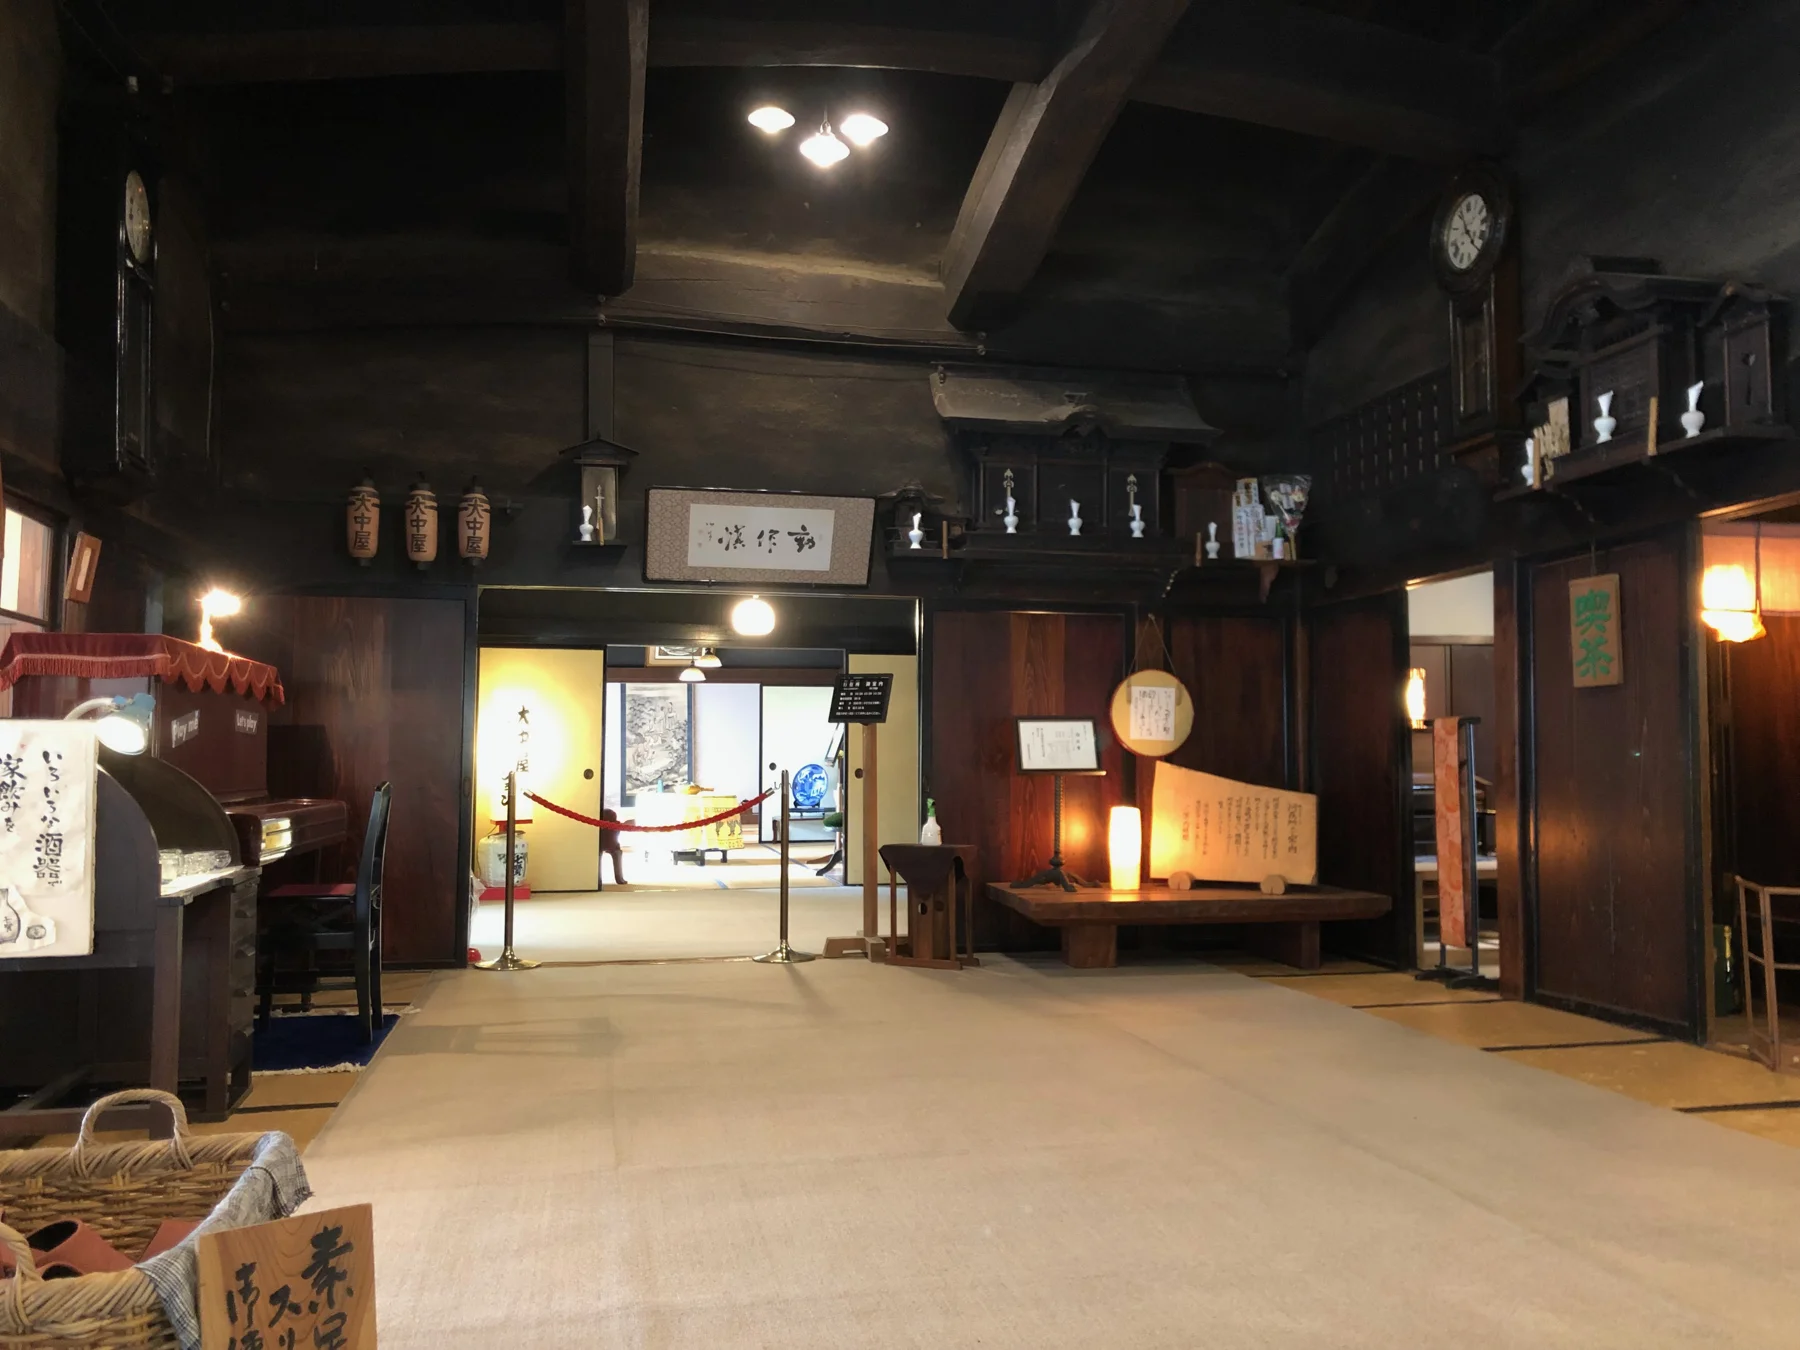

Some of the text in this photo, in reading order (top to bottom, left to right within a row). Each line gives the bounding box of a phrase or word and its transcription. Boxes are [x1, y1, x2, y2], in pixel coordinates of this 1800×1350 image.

[354, 494, 372, 551] 大中屋
[410, 497, 428, 553] 大中屋
[465, 499, 484, 554] 大中屋
[1574, 589, 1613, 680] 喫茶
[171, 720, 187, 749] Play
[247, 714, 258, 733] play
[33, 750, 63, 886] いろいろな酒器で
